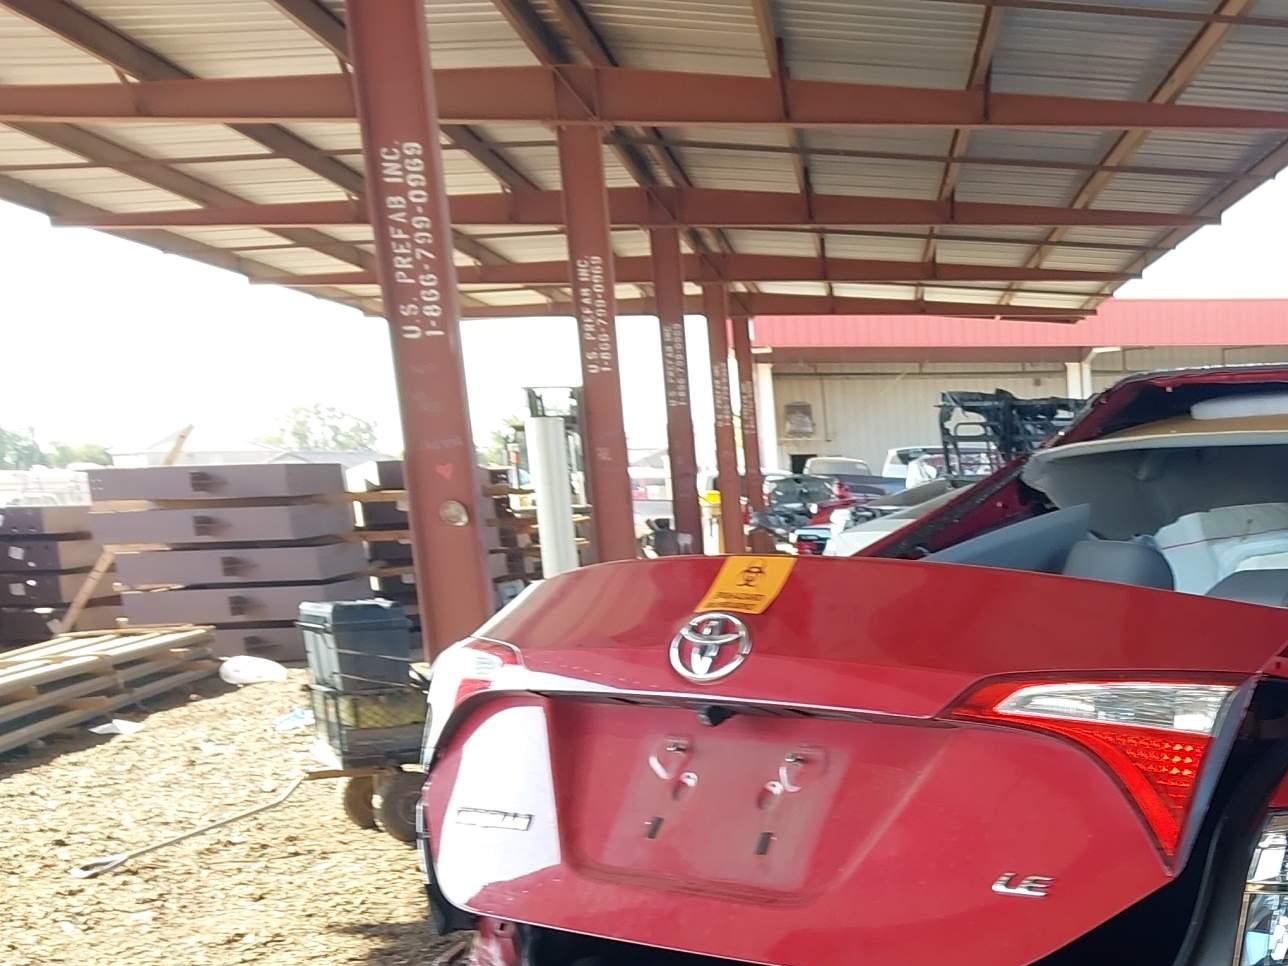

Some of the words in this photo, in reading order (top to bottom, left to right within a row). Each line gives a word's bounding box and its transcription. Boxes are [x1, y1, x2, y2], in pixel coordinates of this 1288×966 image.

[379, 140, 405, 184] INC.
[386, 195, 416, 285] PREFAB
[402, 141, 445, 337] 1-866-799-0969
[399, 296, 423, 339] U.S.
[991, 872, 1057, 897] LE
